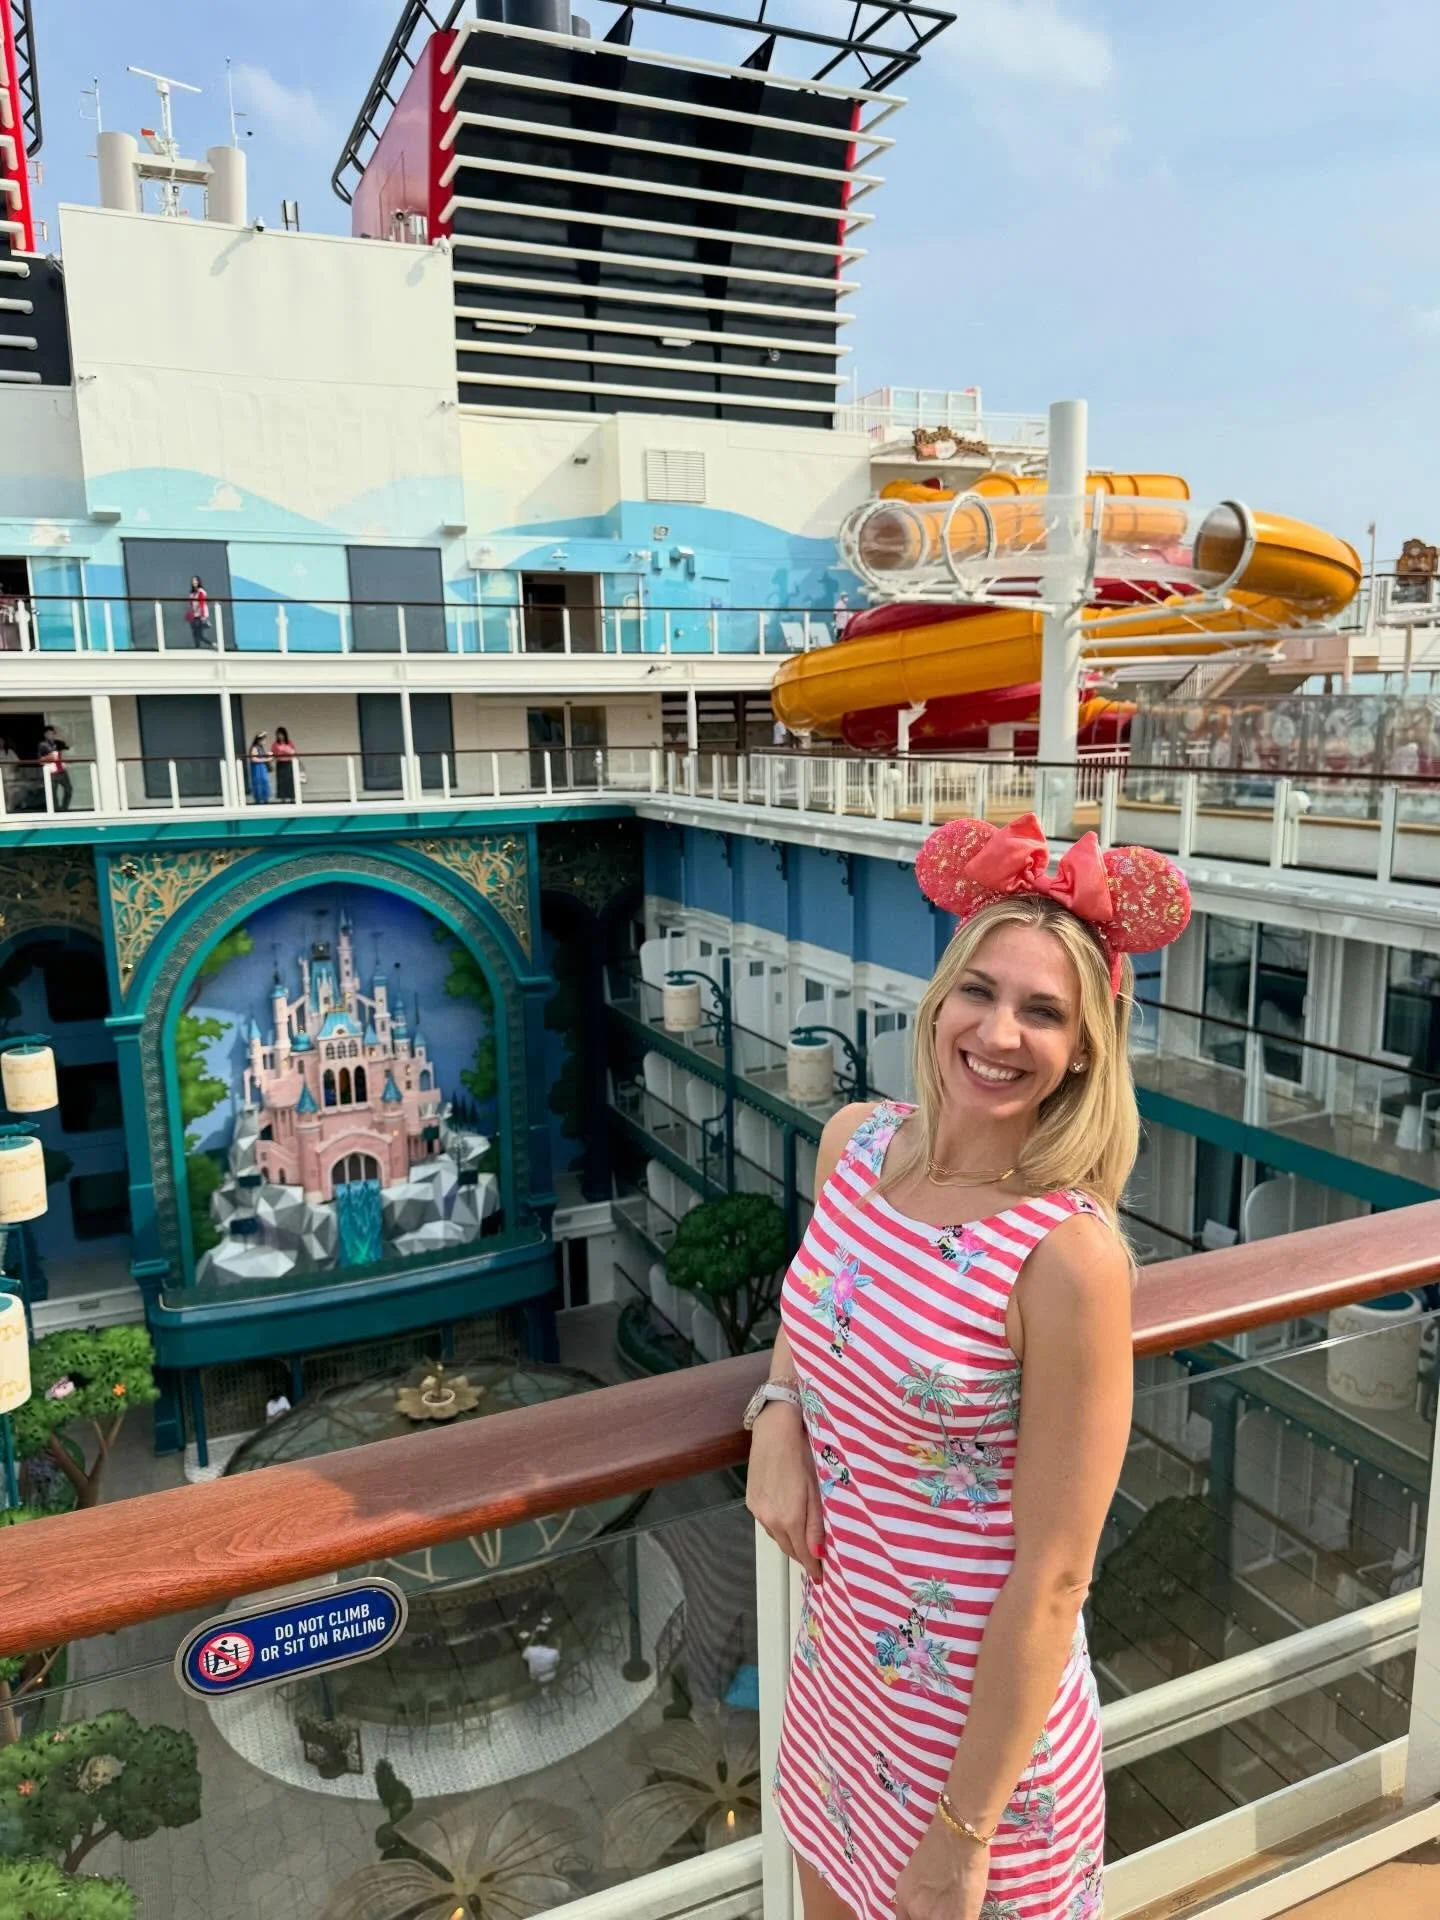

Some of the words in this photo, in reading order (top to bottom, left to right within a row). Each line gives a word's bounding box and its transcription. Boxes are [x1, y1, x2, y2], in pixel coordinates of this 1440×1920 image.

[261, 1646, 279, 1662] OR
[284, 1640, 305, 1656] SIT
[310, 1633, 328, 1649] ON
[333, 1617, 385, 1643] RAILING
[275, 1624, 293, 1641] DO
[298, 1615, 324, 1634] NOT
[329, 1603, 369, 1626] CLIMB
